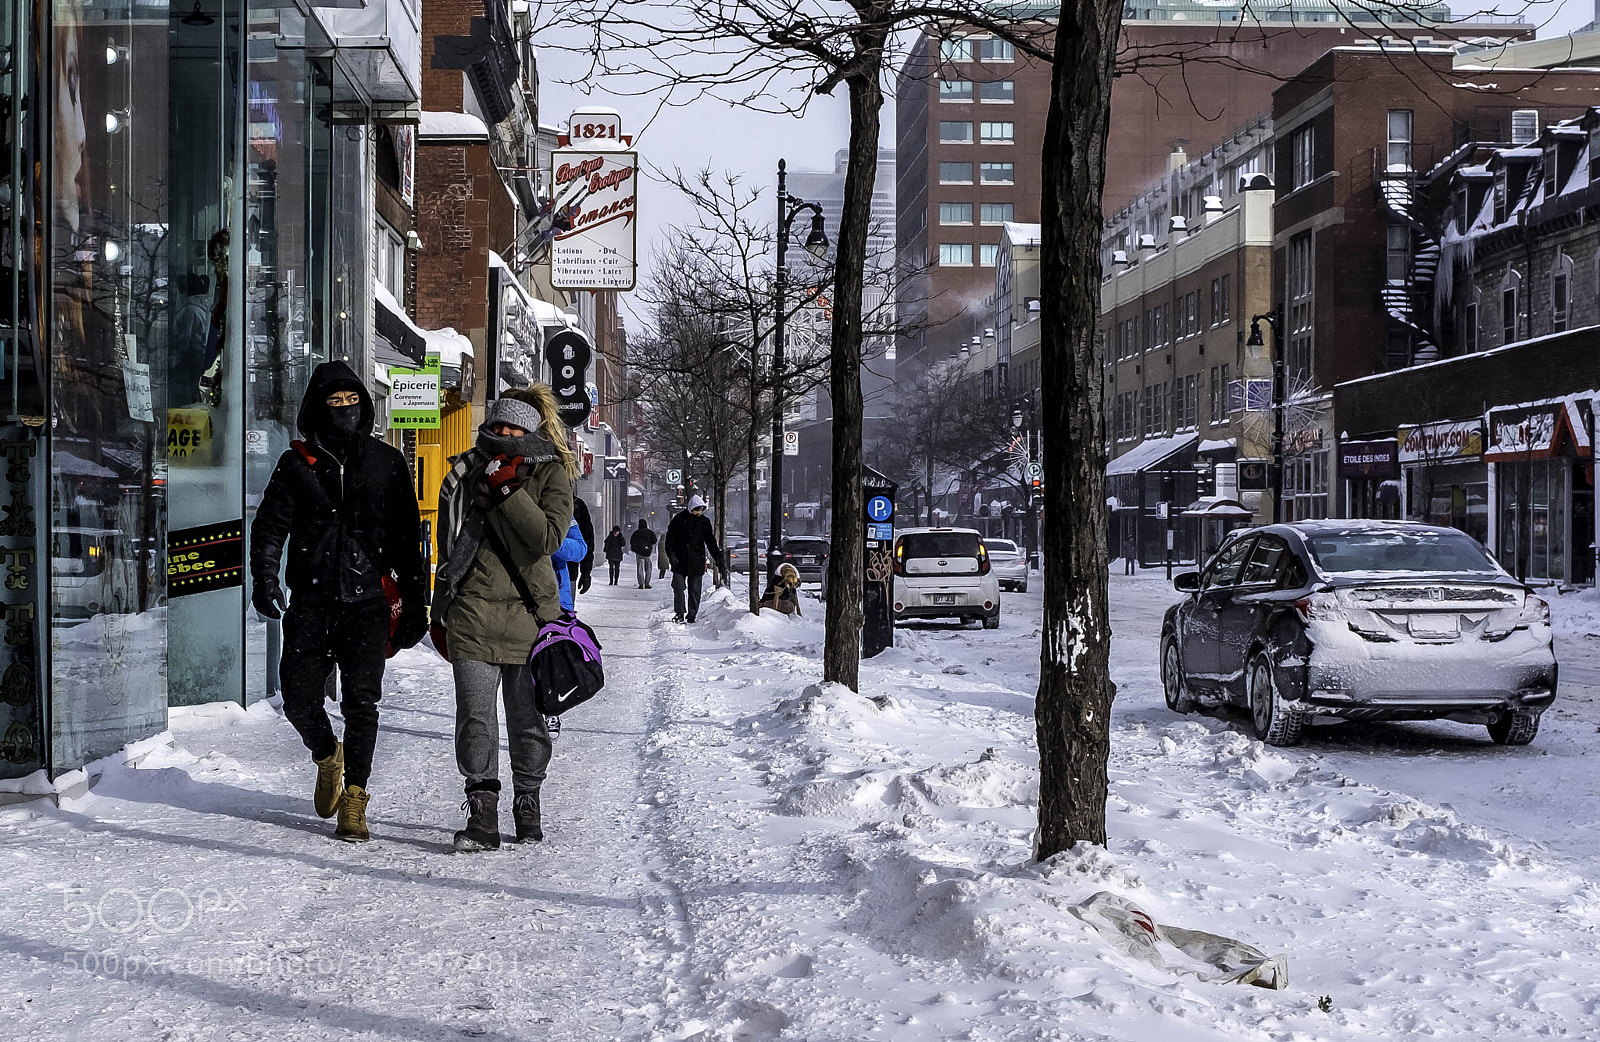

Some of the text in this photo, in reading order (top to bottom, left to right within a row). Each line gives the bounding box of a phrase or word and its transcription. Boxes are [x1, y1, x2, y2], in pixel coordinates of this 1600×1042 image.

[573, 123, 616, 139] 1821
[556, 156, 604, 186] Boutique
[557, 247, 583, 255] Lotions
[603, 247, 617, 255] Dvd
[557, 257, 596, 265] Lubrifiants
[603, 257, 619, 265] Cuir
[557, 267, 594, 275] Vibrateurs
[603, 267, 622, 275] Latex
[556, 277, 596, 285] Accessoires
[393, 379, 437, 392] Épicerie
[1362, 454, 1374, 463] DES
